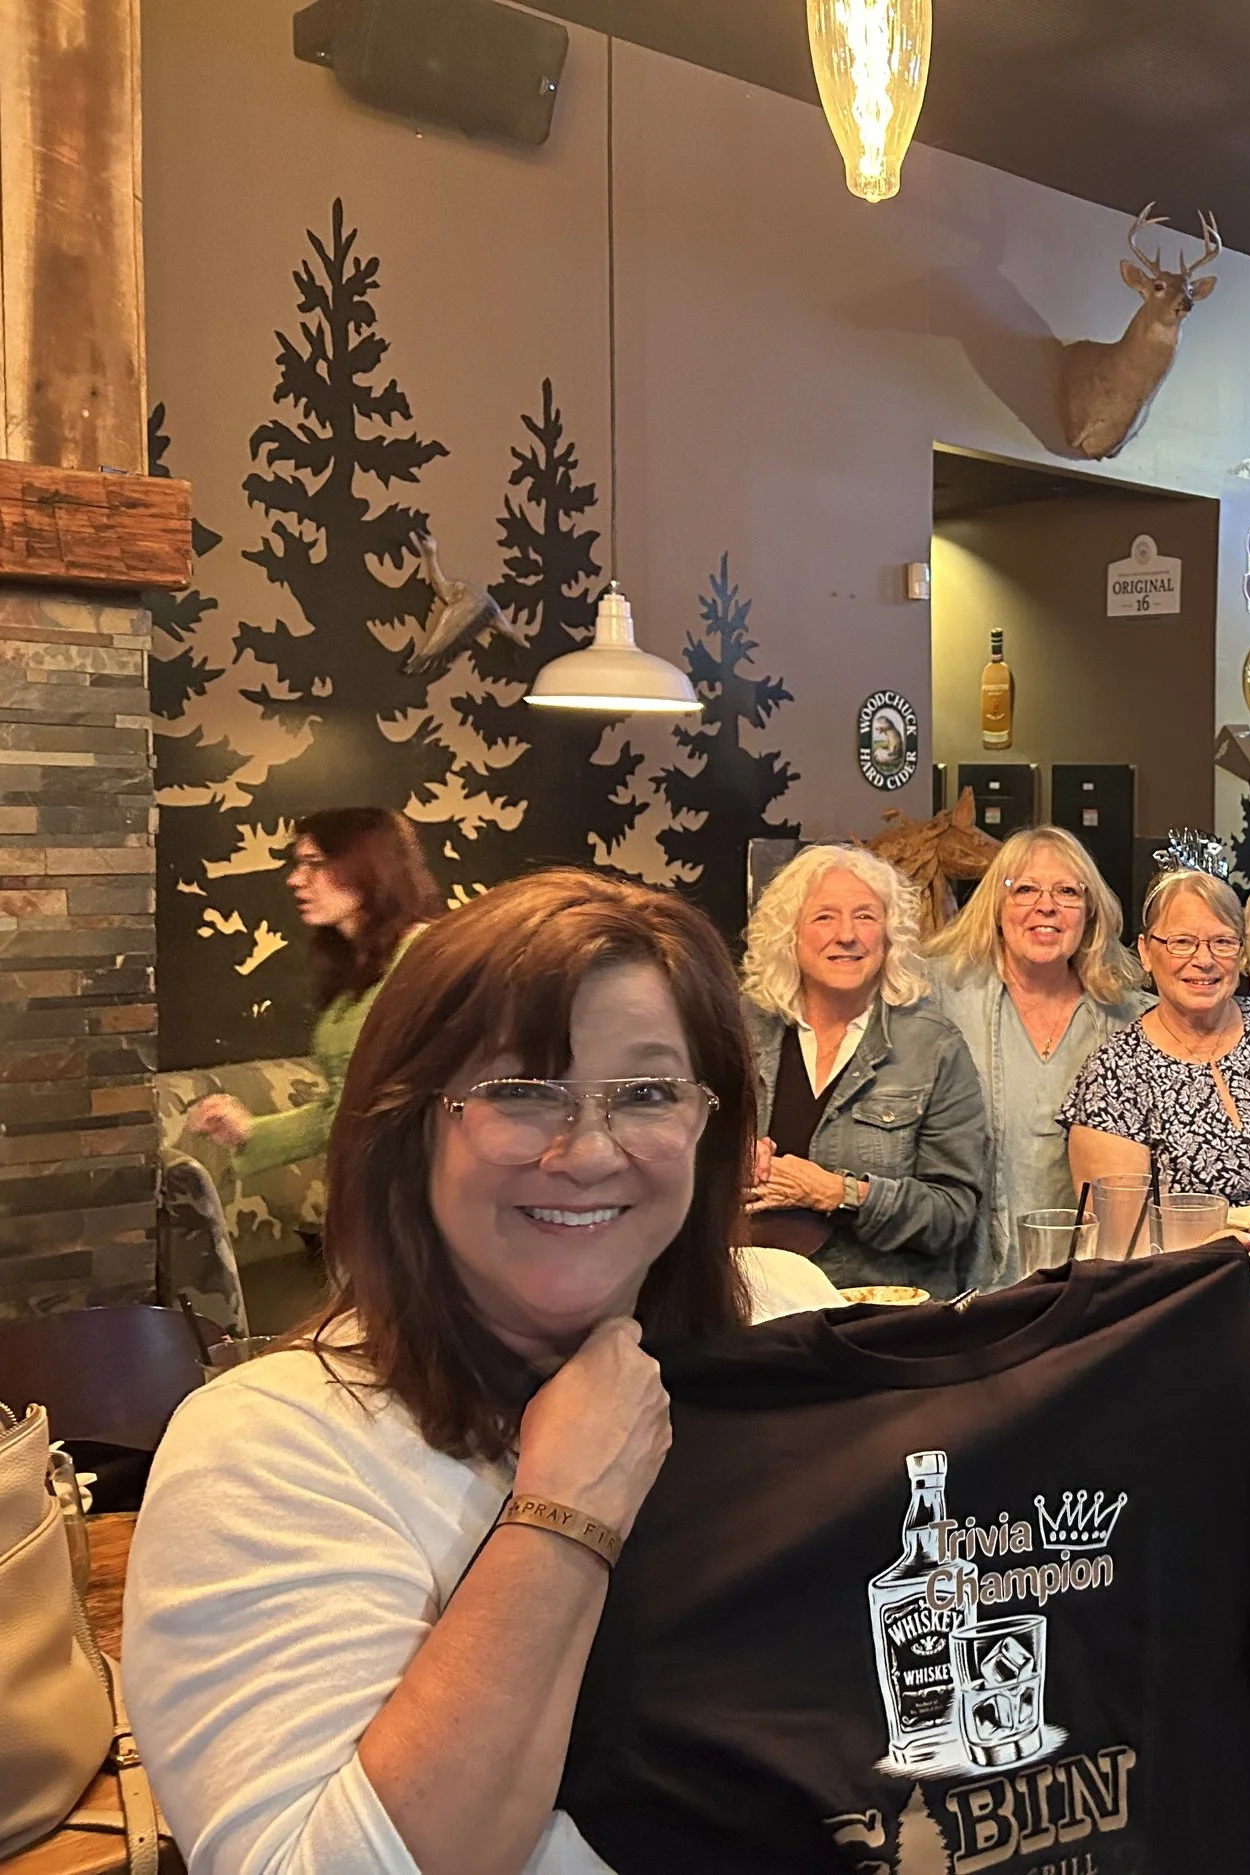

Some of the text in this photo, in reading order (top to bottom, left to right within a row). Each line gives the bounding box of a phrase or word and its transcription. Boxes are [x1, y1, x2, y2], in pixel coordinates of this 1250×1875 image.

[1113, 578, 1174, 595] ORIGINAL
[1136, 594, 1150, 612] 16
[860, 691, 917, 735] WOODCHUCK
[860, 748, 917, 789] HARD CIDER
[522, 1501, 572, 1525] PRAY
[928, 1511, 1033, 1565] Trivia
[926, 1550, 1114, 1612] Champion
[887, 1610, 963, 1647] WHISKEY
